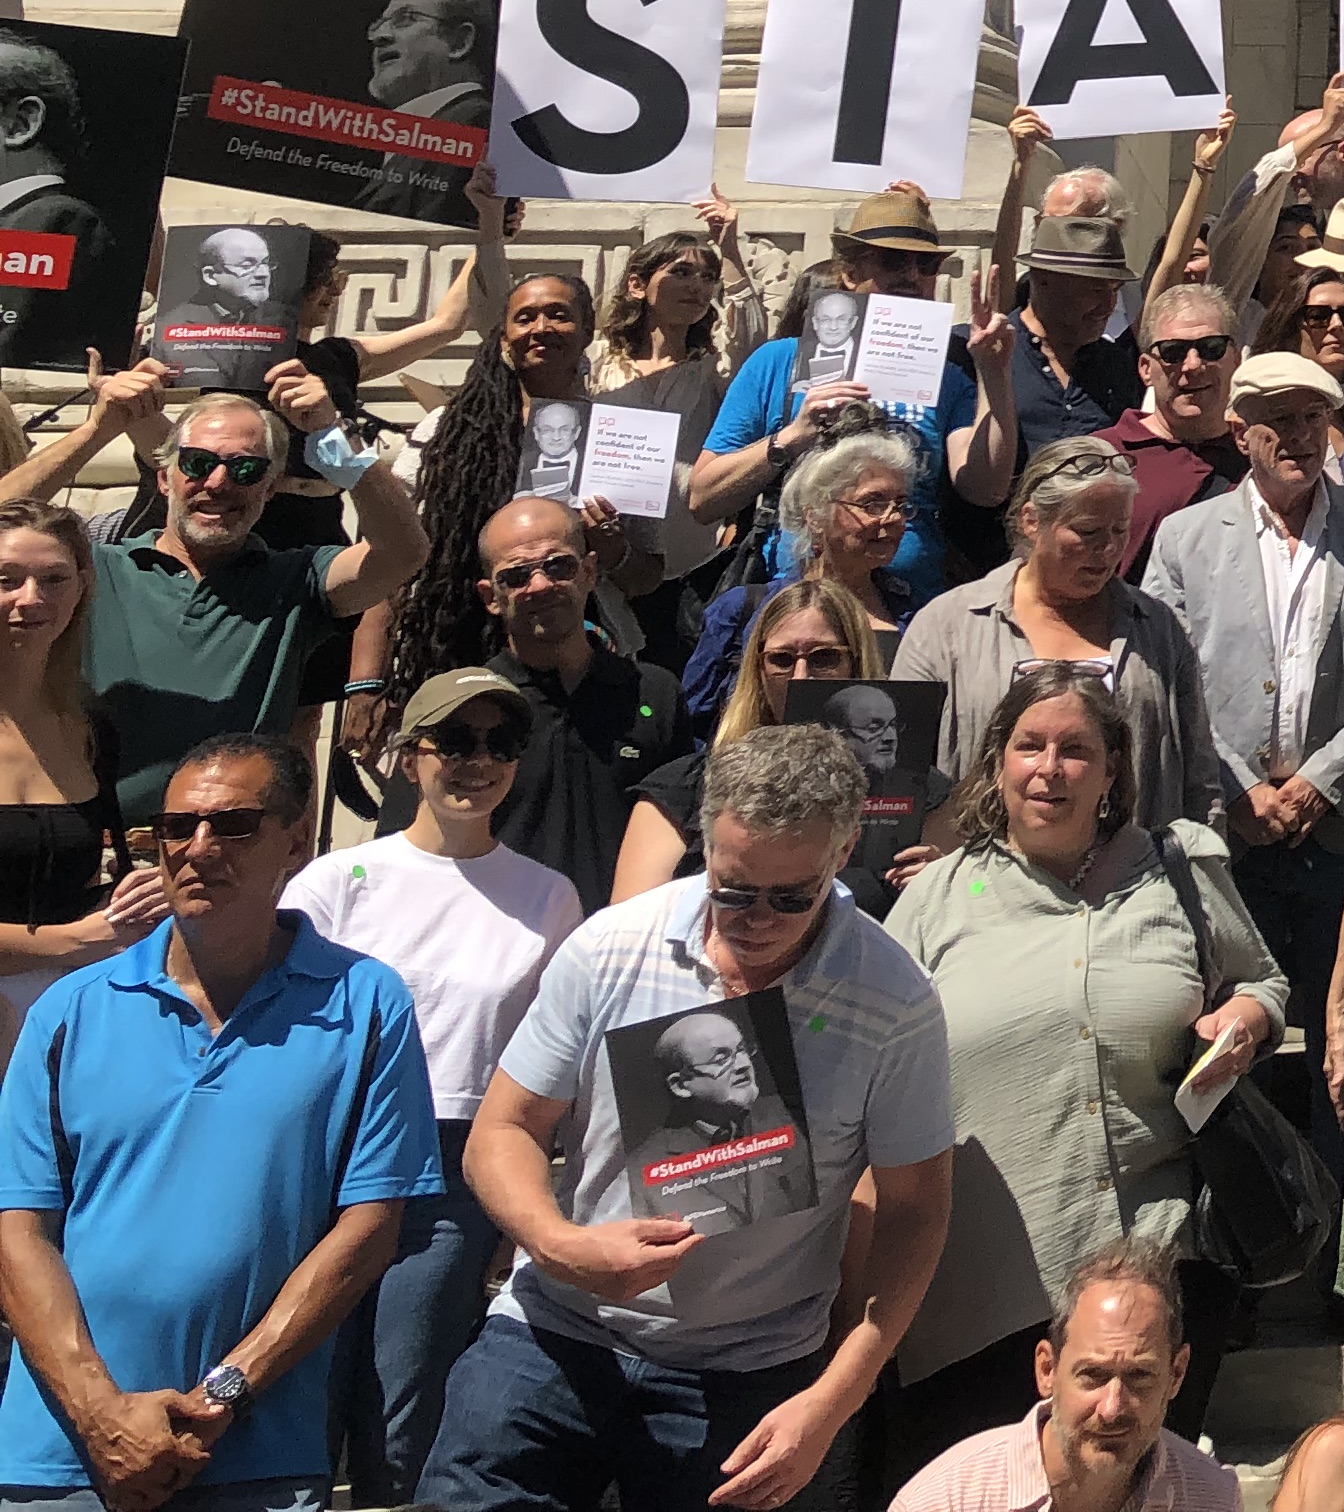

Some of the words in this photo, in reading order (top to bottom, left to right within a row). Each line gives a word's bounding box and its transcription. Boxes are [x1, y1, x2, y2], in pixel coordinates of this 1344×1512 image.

[221, 87, 474, 159] #StandWithSalman
[227, 137, 286, 163] Defend
[287, 149, 312, 167] the
[316, 154, 383, 180] Freedom
[387, 169, 402, 184] to
[409, 171, 450, 192] Write
[168, 327, 281, 340] #StandWithSalman
[649, 1133, 789, 1178] #StandWithSalman
